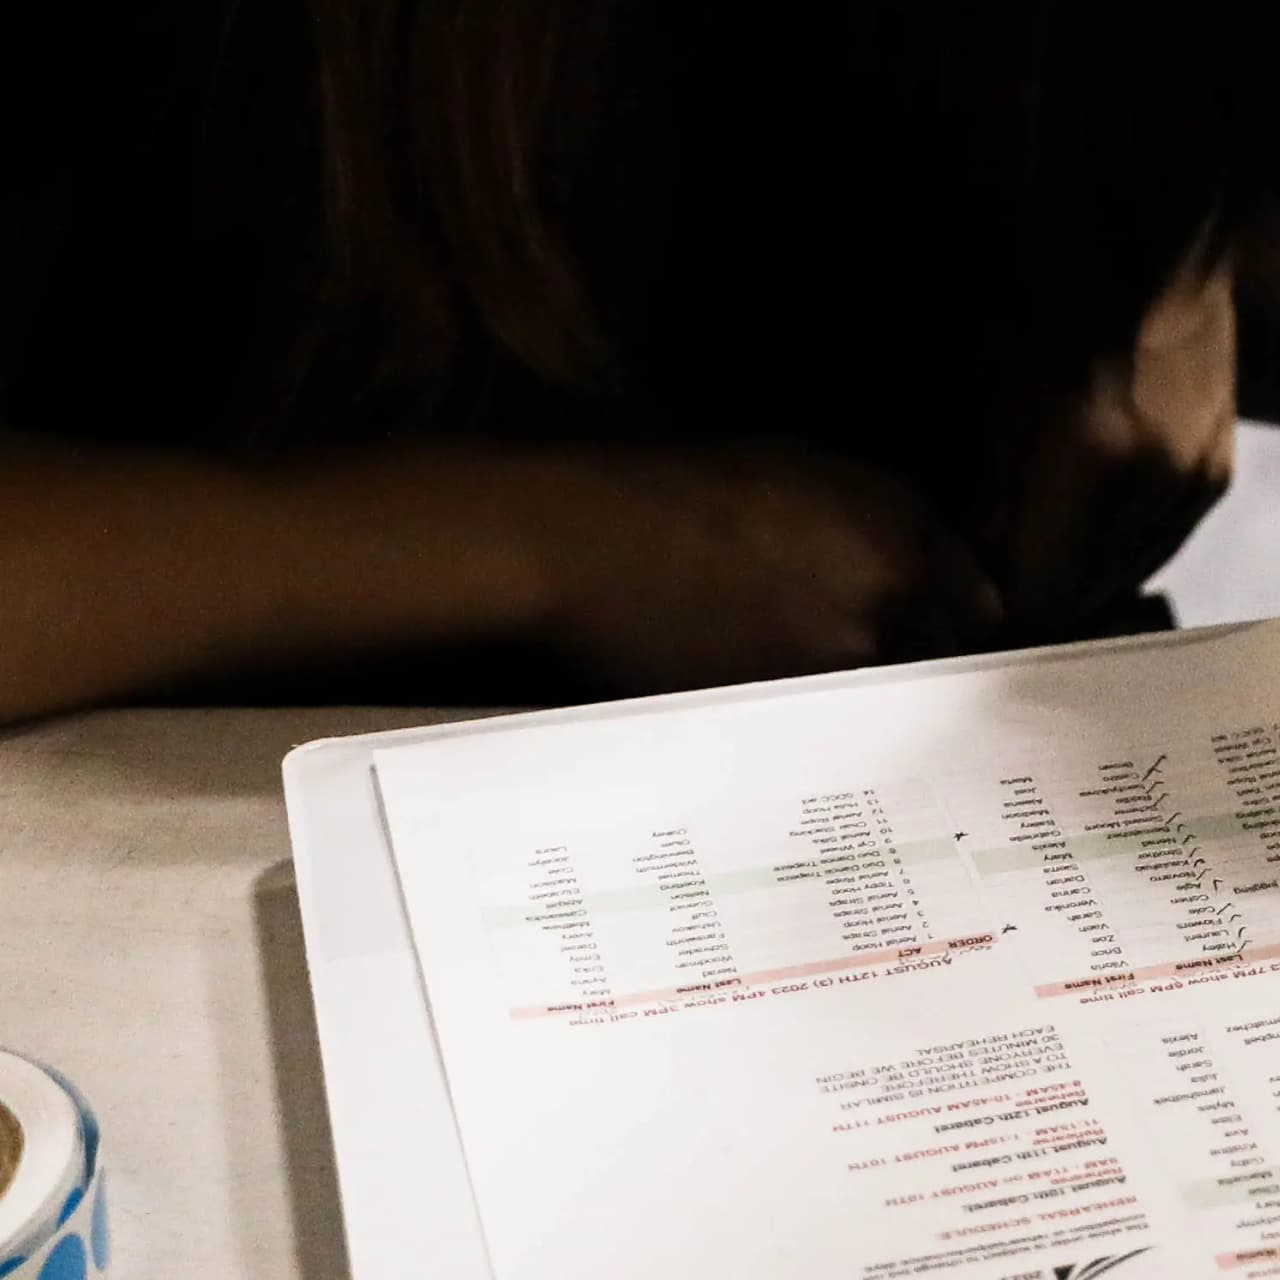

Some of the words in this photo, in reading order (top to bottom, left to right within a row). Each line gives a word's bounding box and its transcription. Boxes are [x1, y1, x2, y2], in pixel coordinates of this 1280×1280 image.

[947, 934, 995, 950] ORDER
[896, 946, 924, 961] ACT
[1214, 951, 1245, 966] Last
[884, 955, 954, 977] AUGUST
[1174, 958, 1214, 974] Name
[1232, 966, 1268, 980] 7PM
[714, 977, 743, 990] Last
[812, 977, 835, 990] (3)
[838, 971, 880, 986] 12TH
[1064, 977, 1104, 991] Name
[1104, 972, 1136, 985] First
[1188, 974, 1230, 987] show
[676, 983, 713, 995] Name
[771, 982, 810, 997] 2023
[1118, 988, 1146, 1000] call
[684, 997, 727, 1009] show
[732, 991, 767, 1003] 4PM
[1080, 994, 1116, 1005] time
[546, 1003, 584, 1013] Name
[586, 999, 616, 1010] First
[1035, 1097, 1090, 1116] August
[933, 1116, 996, 1135] Cabaret
[1051, 1136, 1109, 1155] August
[951, 1154, 1014, 1174] Cabaret
[1071, 1174, 1128, 1194] August
